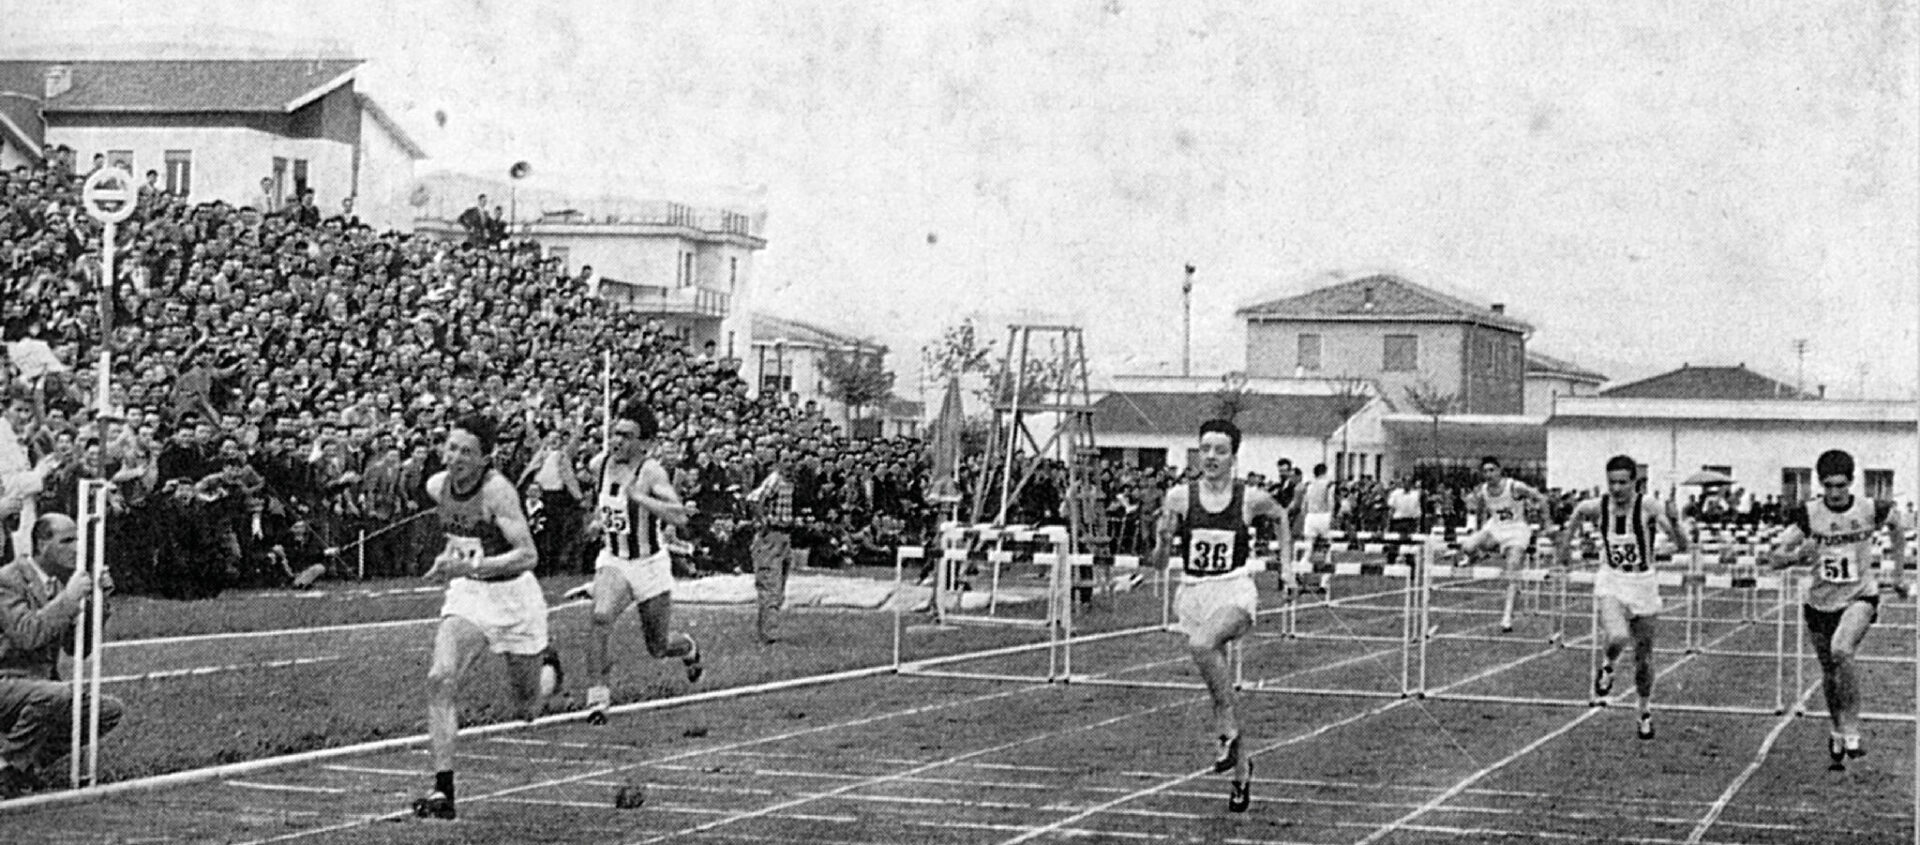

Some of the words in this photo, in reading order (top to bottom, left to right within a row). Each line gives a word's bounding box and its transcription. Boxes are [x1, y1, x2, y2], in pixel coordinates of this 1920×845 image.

[602, 505, 627, 531] 35
[1193, 540, 1228, 569] 36
[1823, 556, 1849, 579] 51
